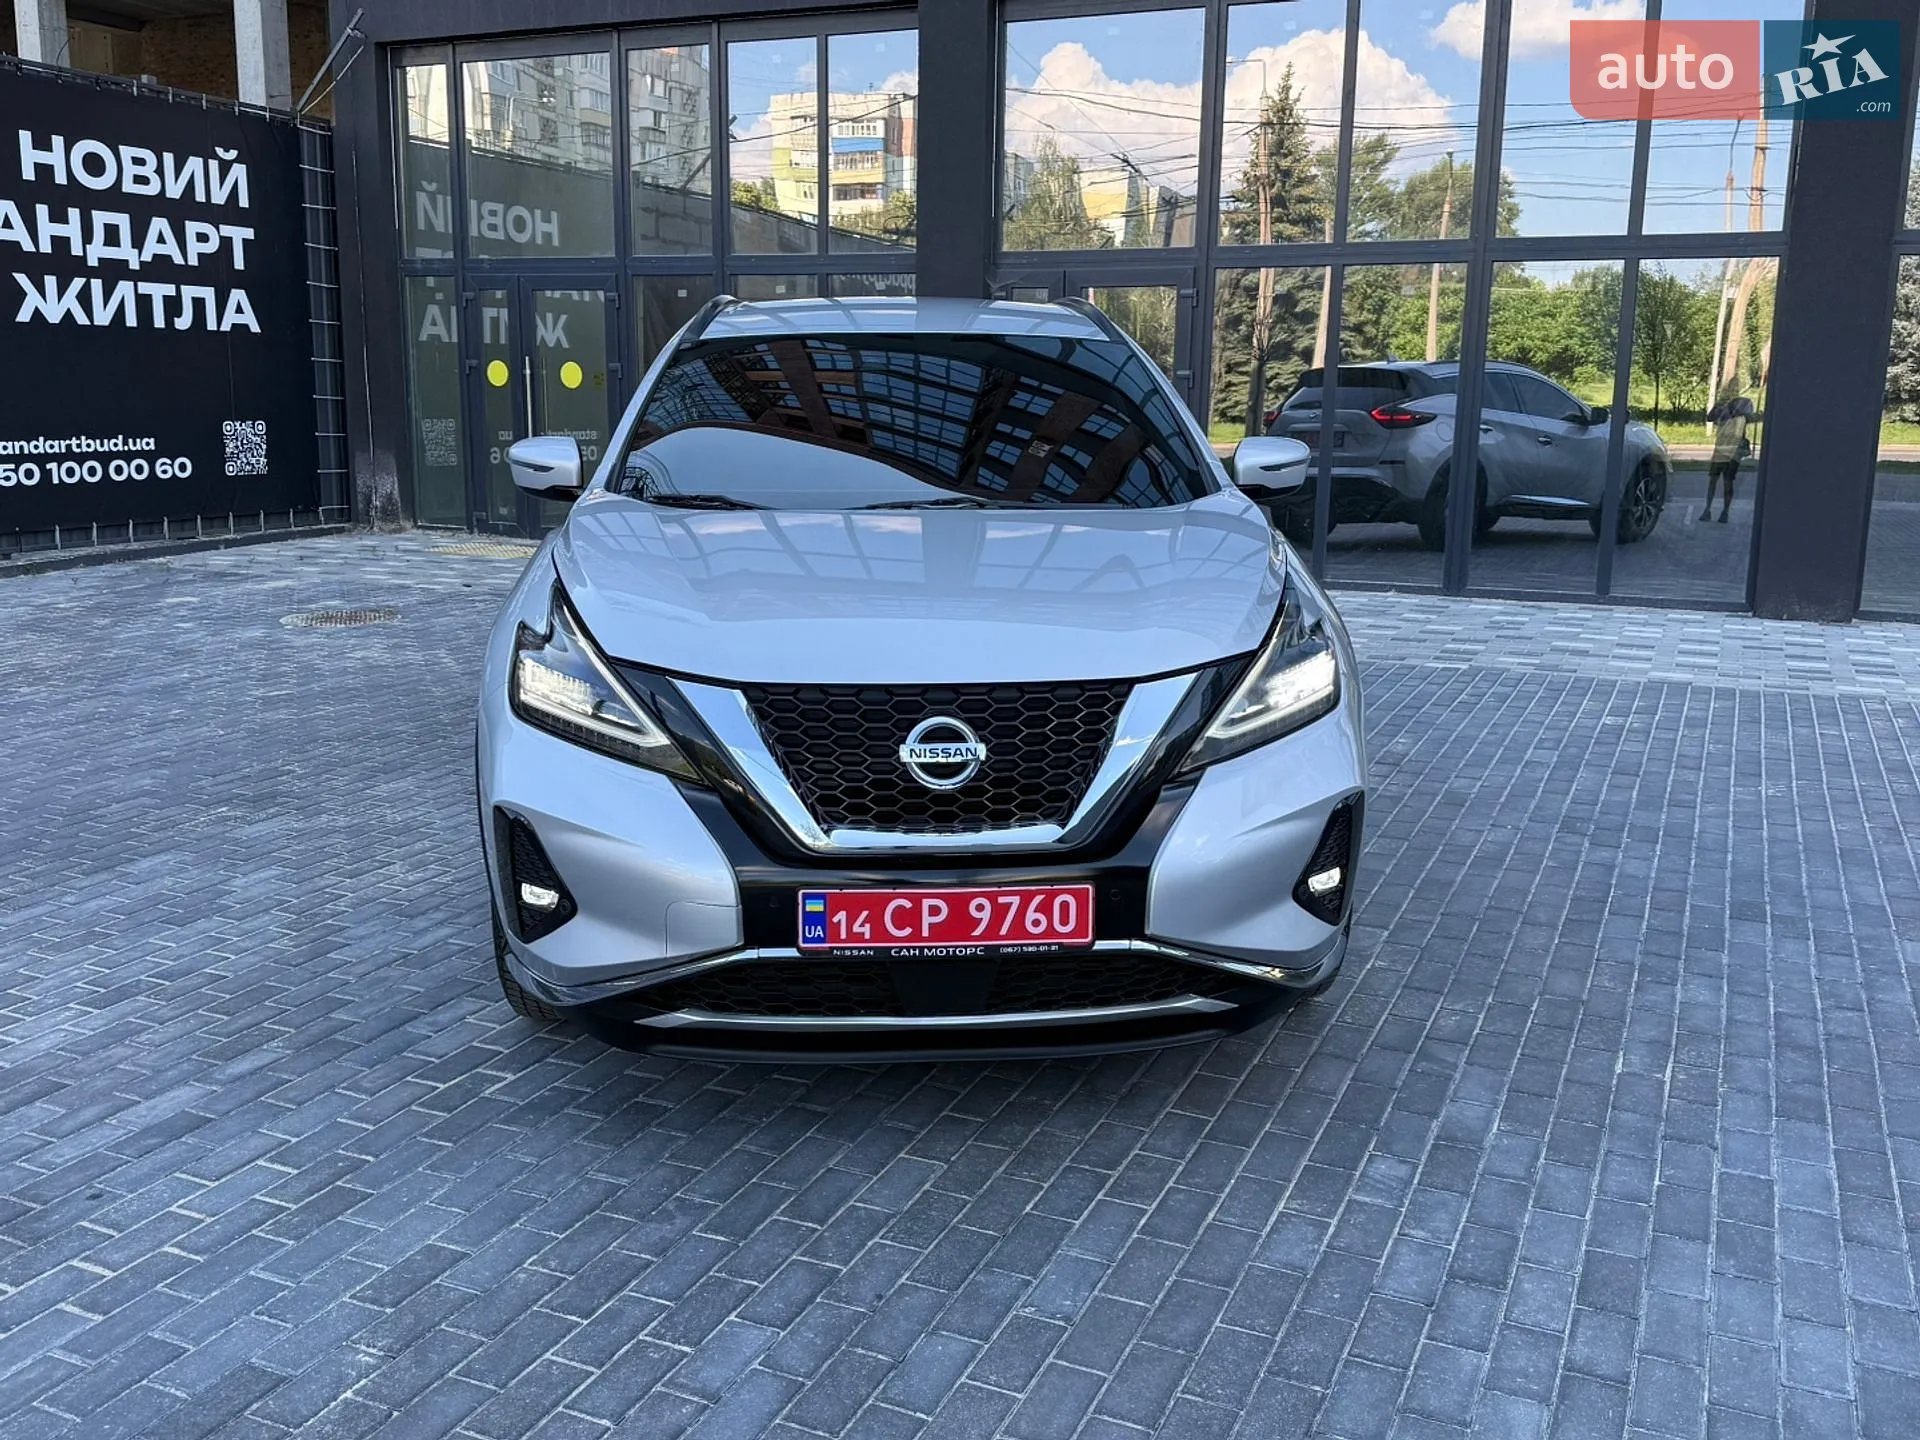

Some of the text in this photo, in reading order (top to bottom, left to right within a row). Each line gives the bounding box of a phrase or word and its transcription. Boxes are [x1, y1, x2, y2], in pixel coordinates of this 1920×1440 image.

[18, 129, 250, 208] НОВИЙ
[0, 199, 255, 271] АНДАРТ
[11, 271, 261, 334] ЖИТЛА
[0, 434, 156, 456] andartbud.ua
[0, 456, 193, 487] 50 100 00 60
[909, 747, 977, 759] NISSAN
[805, 894, 1077, 940] UA 14 CP 9760
[832, 949, 875, 957] NISSAN
[891, 946, 986, 957] САН МОТОРС
